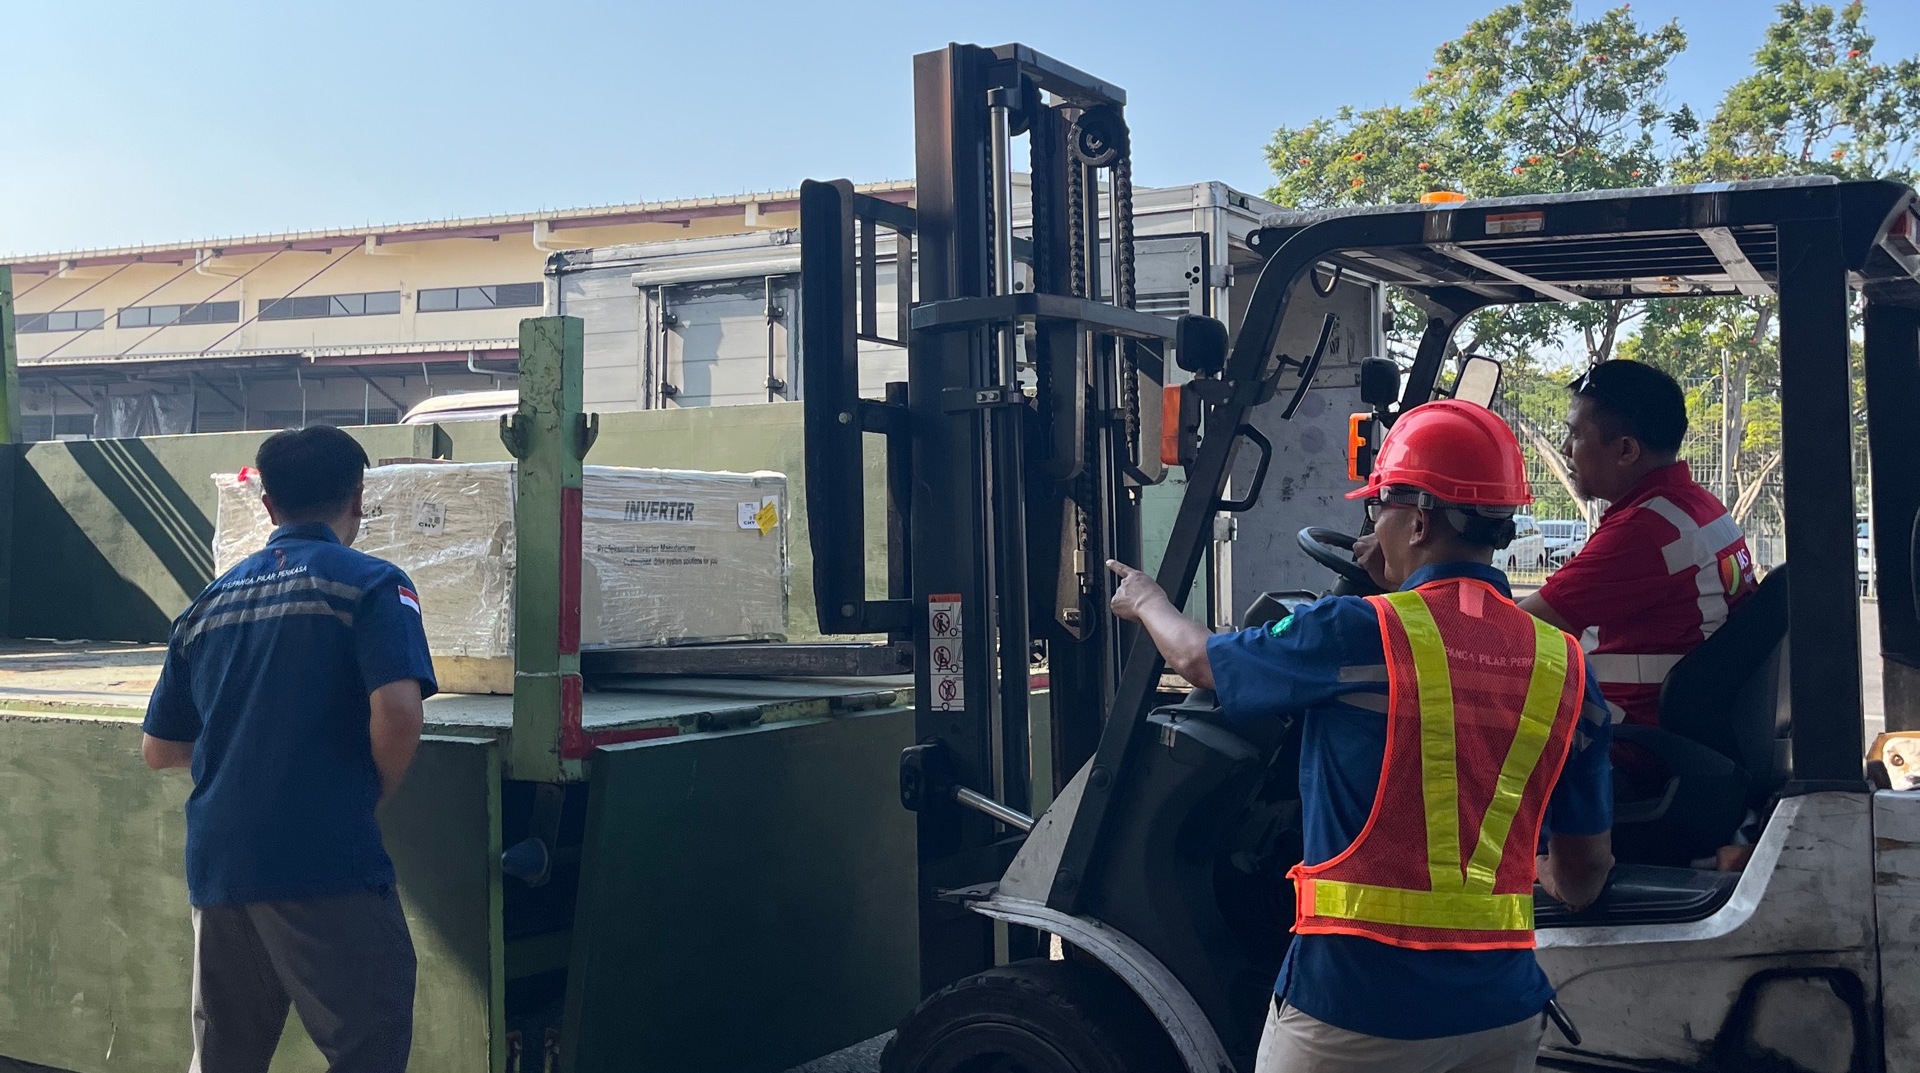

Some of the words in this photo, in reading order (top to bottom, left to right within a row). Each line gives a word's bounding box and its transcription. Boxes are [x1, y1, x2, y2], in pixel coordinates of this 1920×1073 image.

[624, 500, 695, 521] INVERTER
[256, 573, 275, 582] PILAR
[277, 565, 307, 578] PERKASA
[1479, 653, 1507, 667] PILAR
